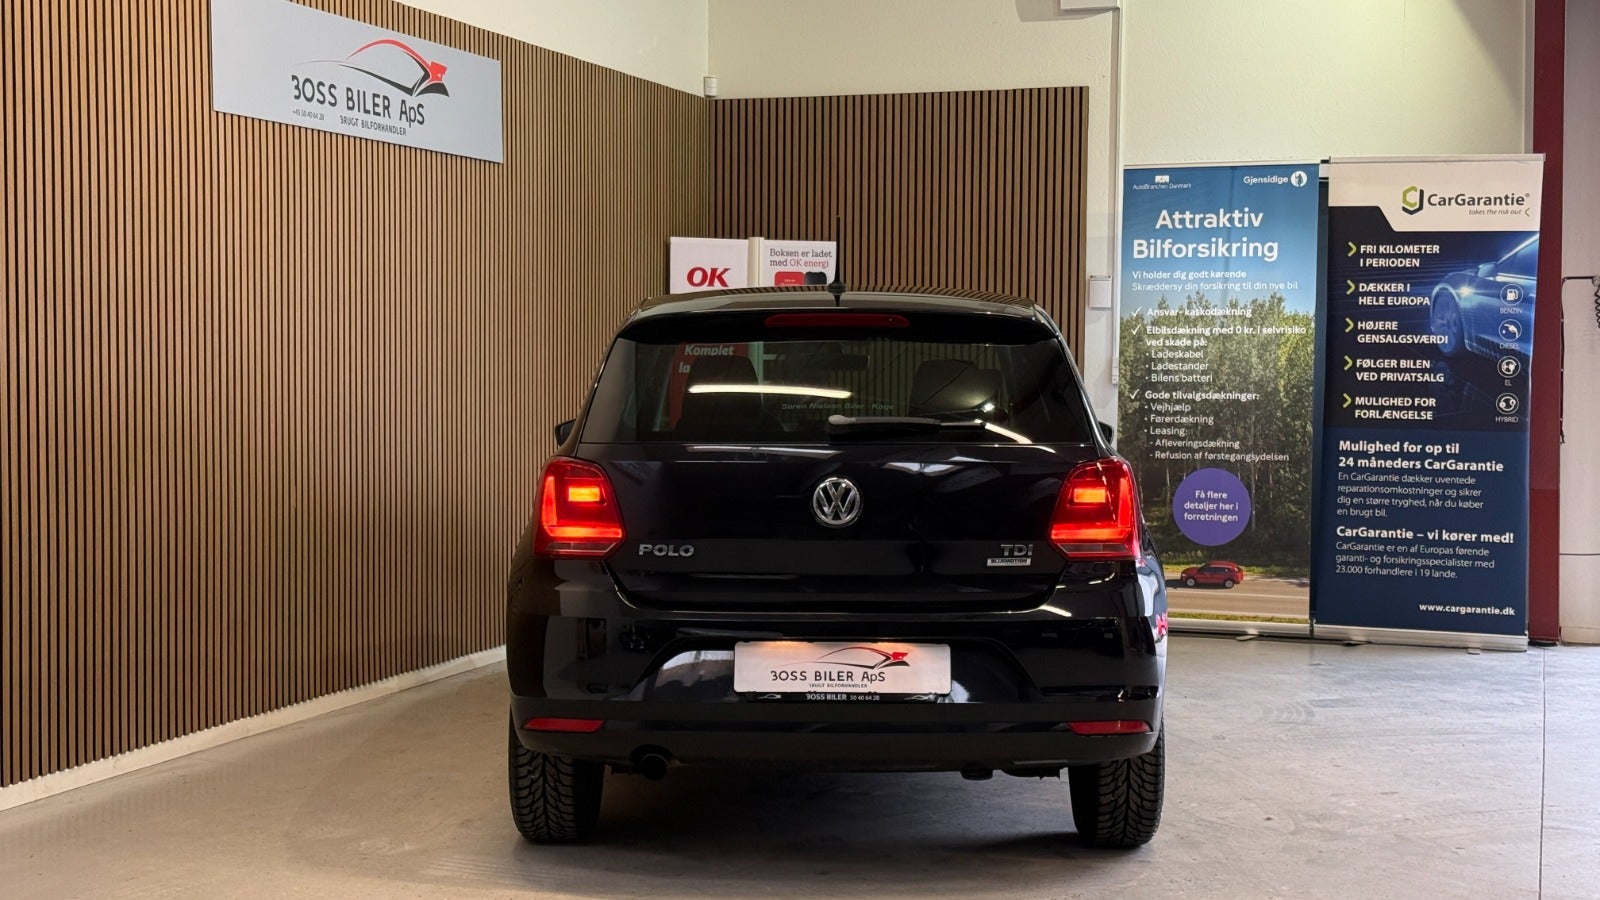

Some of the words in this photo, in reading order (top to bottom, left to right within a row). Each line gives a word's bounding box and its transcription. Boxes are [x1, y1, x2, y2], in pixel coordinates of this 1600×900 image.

[346, 87, 391, 119] BILER
[399, 99, 425, 128] ApS
[361, 120, 407, 136] BILFORHANDLER
[1243, 175, 1289, 186] Gjensidige
[1155, 207, 1264, 230] Attraktiv
[770, 248, 799, 257] Boksen
[811, 249, 833, 258] ladet
[1132, 237, 1278, 262] Bilforsikring
[1360, 244, 1377, 254] FRI
[1379, 244, 1440, 254] KILOMETER
[770, 259, 788, 267] med
[789, 258, 803, 267] OK
[804, 260, 829, 269] energi
[1366, 258, 1420, 267] PERIODEN
[686, 266, 731, 287] OK
[1132, 271, 1141, 279] Vi
[1143, 271, 1171, 279] holder
[1173, 271, 1187, 281] dig
[1188, 270, 1209, 280] godt
[1210, 270, 1247, 279] kørende
[1132, 282, 1184, 292] Skræddersy
[1185, 281, 1199, 291] din
[1200, 281, 1241, 292] forsikring
[1242, 281, 1252, 290] til
[1253, 281, 1268, 290] din
[1269, 282, 1285, 292] nye
[1287, 280, 1299, 290] bil
[1359, 283, 1405, 292] DÆKKER
[1359, 296, 1386, 306] HELE
[1387, 296, 1431, 306] EUROPA
[1185, 307, 1252, 318] kaskodækning
[1146, 325, 1211, 336] Elbilsdækning
[1212, 326, 1234, 334] med
[1243, 326, 1256, 334] kr.
[1262, 326, 1307, 334] selvrisiko
[1358, 320, 1399, 331] HØJERE
[1146, 338, 1164, 347] ved
[1165, 338, 1192, 347] skade
[1193, 338, 1208, 348] på:
[1357, 334, 1449, 344] GENSALGSVÆRDI
[684, 343, 735, 356] Komplet
[1151, 350, 1204, 359] Ladeskabel
[1151, 362, 1209, 370] Ladestander
[1356, 358, 1398, 369] FØLGER
[1400, 359, 1431, 369] BILEN
[1151, 373, 1180, 382] Bilens
[1181, 373, 1213, 382] batteri
[1356, 372, 1378, 382] VED
[1380, 372, 1445, 383] PRIVATSALG
[1145, 390, 1170, 400] Gode
[1172, 390, 1260, 401] tilvalgsdækninger:
[1150, 402, 1191, 412] Vejhjælp
[1355, 396, 1412, 407] MULIGHED
[1414, 398, 1437, 407] FOR
[1150, 414, 1214, 425] Førerdækning
[1355, 410, 1434, 420] FORLÆNGELSE
[1155, 438, 1240, 449] Afleveringsdækning
[1339, 440, 1400, 453] Mulighed
[1403, 442, 1422, 453] for
[1425, 444, 1443, 456] op
[1445, 442, 1460, 454] til
[1155, 451, 1192, 460] Refusion
[1194, 452, 1203, 460] af
[1338, 457, 1354, 468] 24
[1357, 457, 1421, 469] måneders
[1424, 459, 1504, 472] CarGarantie
[1338, 473, 1349, 481] En
[1350, 473, 1400, 482] CarGarantie
[1401, 474, 1433, 484] dækker
[1435, 476, 1477, 485] uventede
[1195, 490, 1206, 499] Få
[1207, 490, 1228, 499] flere
[1338, 484, 1443, 497] reparationsomkostninger
[1444, 489, 1457, 498] og
[1458, 488, 1482, 497] sikrer
[1184, 502, 1217, 511] detaljer
[1219, 502, 1234, 511] her
[1337, 496, 1351, 506] dig
[1365, 497, 1390, 506] større
[1391, 497, 1427, 508] tryghed,
[1428, 498, 1443, 507] når
[1444, 499, 1457, 508] du
[1458, 500, 1484, 509] køber
[1184, 513, 1239, 523] forretningen
[1349, 508, 1373, 518] brugt
[1375, 508, 1388, 517] bil.
[1336, 526, 1414, 539] CarGarantie
[1427, 529, 1439, 540] vi
[1442, 530, 1477, 541] kører
[1480, 531, 1515, 543] med!
[638, 544, 695, 557] POLO
[1000, 544, 1034, 556] TDI
[1335, 541, 1385, 552] CarGarantie
[1409, 544, 1419, 553] af
[1420, 545, 1454, 555] Europas
[1455, 546, 1490, 556] førende
[1335, 554, 1368, 564] garanti-
[1369, 557, 1382, 565] og
[1383, 556, 1473, 568] forsikringsspecialister
[1474, 559, 1495, 568] med
[1335, 565, 1363, 574] 23.000
[1364, 567, 1413, 577] forhandlere
[1419, 569, 1430, 577] 19
[1431, 569, 1458, 579] lande.
[1418, 602, 1515, 616] www.cargarantie.dk
[814, 670, 854, 682] BILER
[861, 671, 886, 685] ApS
[826, 693, 848, 701] BILER
